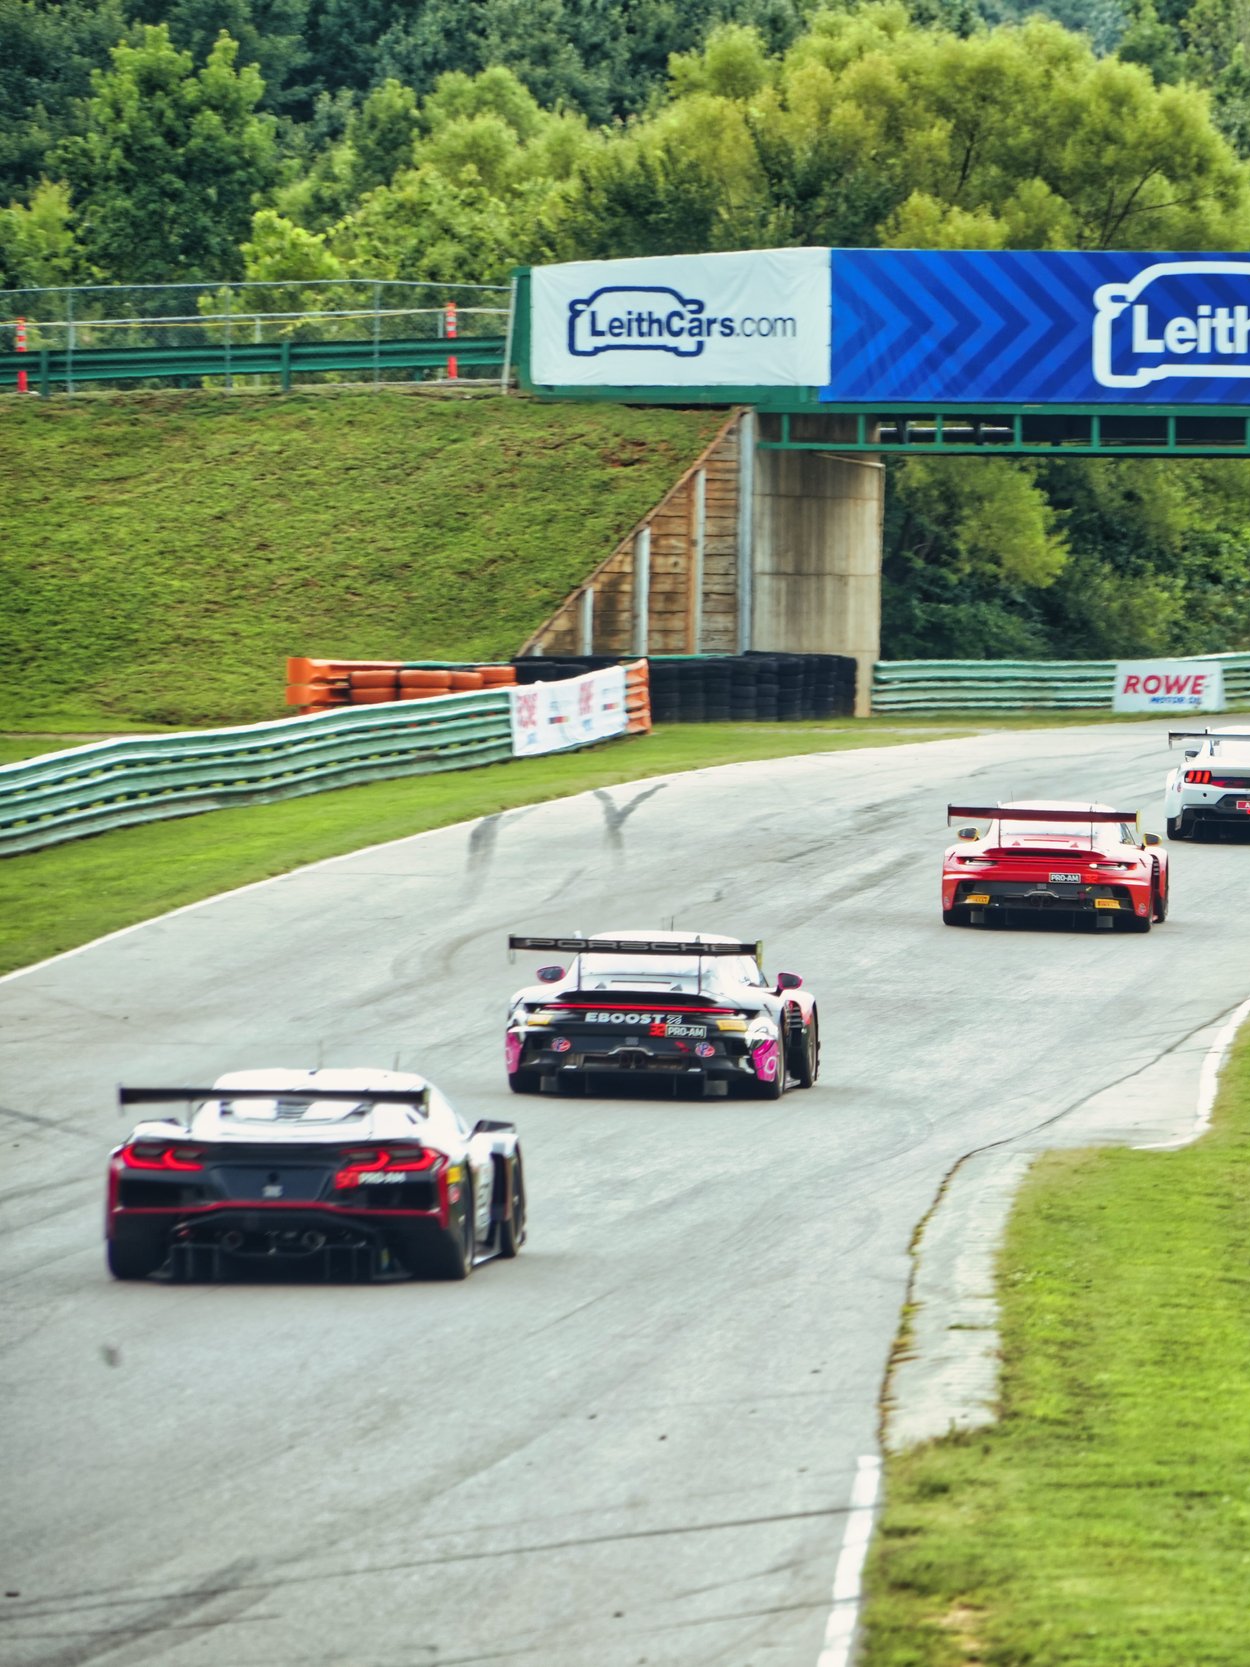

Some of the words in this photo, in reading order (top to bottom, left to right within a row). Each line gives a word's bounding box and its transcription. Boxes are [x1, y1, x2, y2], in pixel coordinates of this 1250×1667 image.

[590, 310, 797, 338] LeithCars.com
[1122, 674, 1208, 695] ROWE
[1051, 874, 1079, 882] PRO-AM
[525, 938, 742, 952] PORSCHE
[584, 1012, 665, 1024] EBOOST
[667, 1027, 704, 1037] PRO-AM
